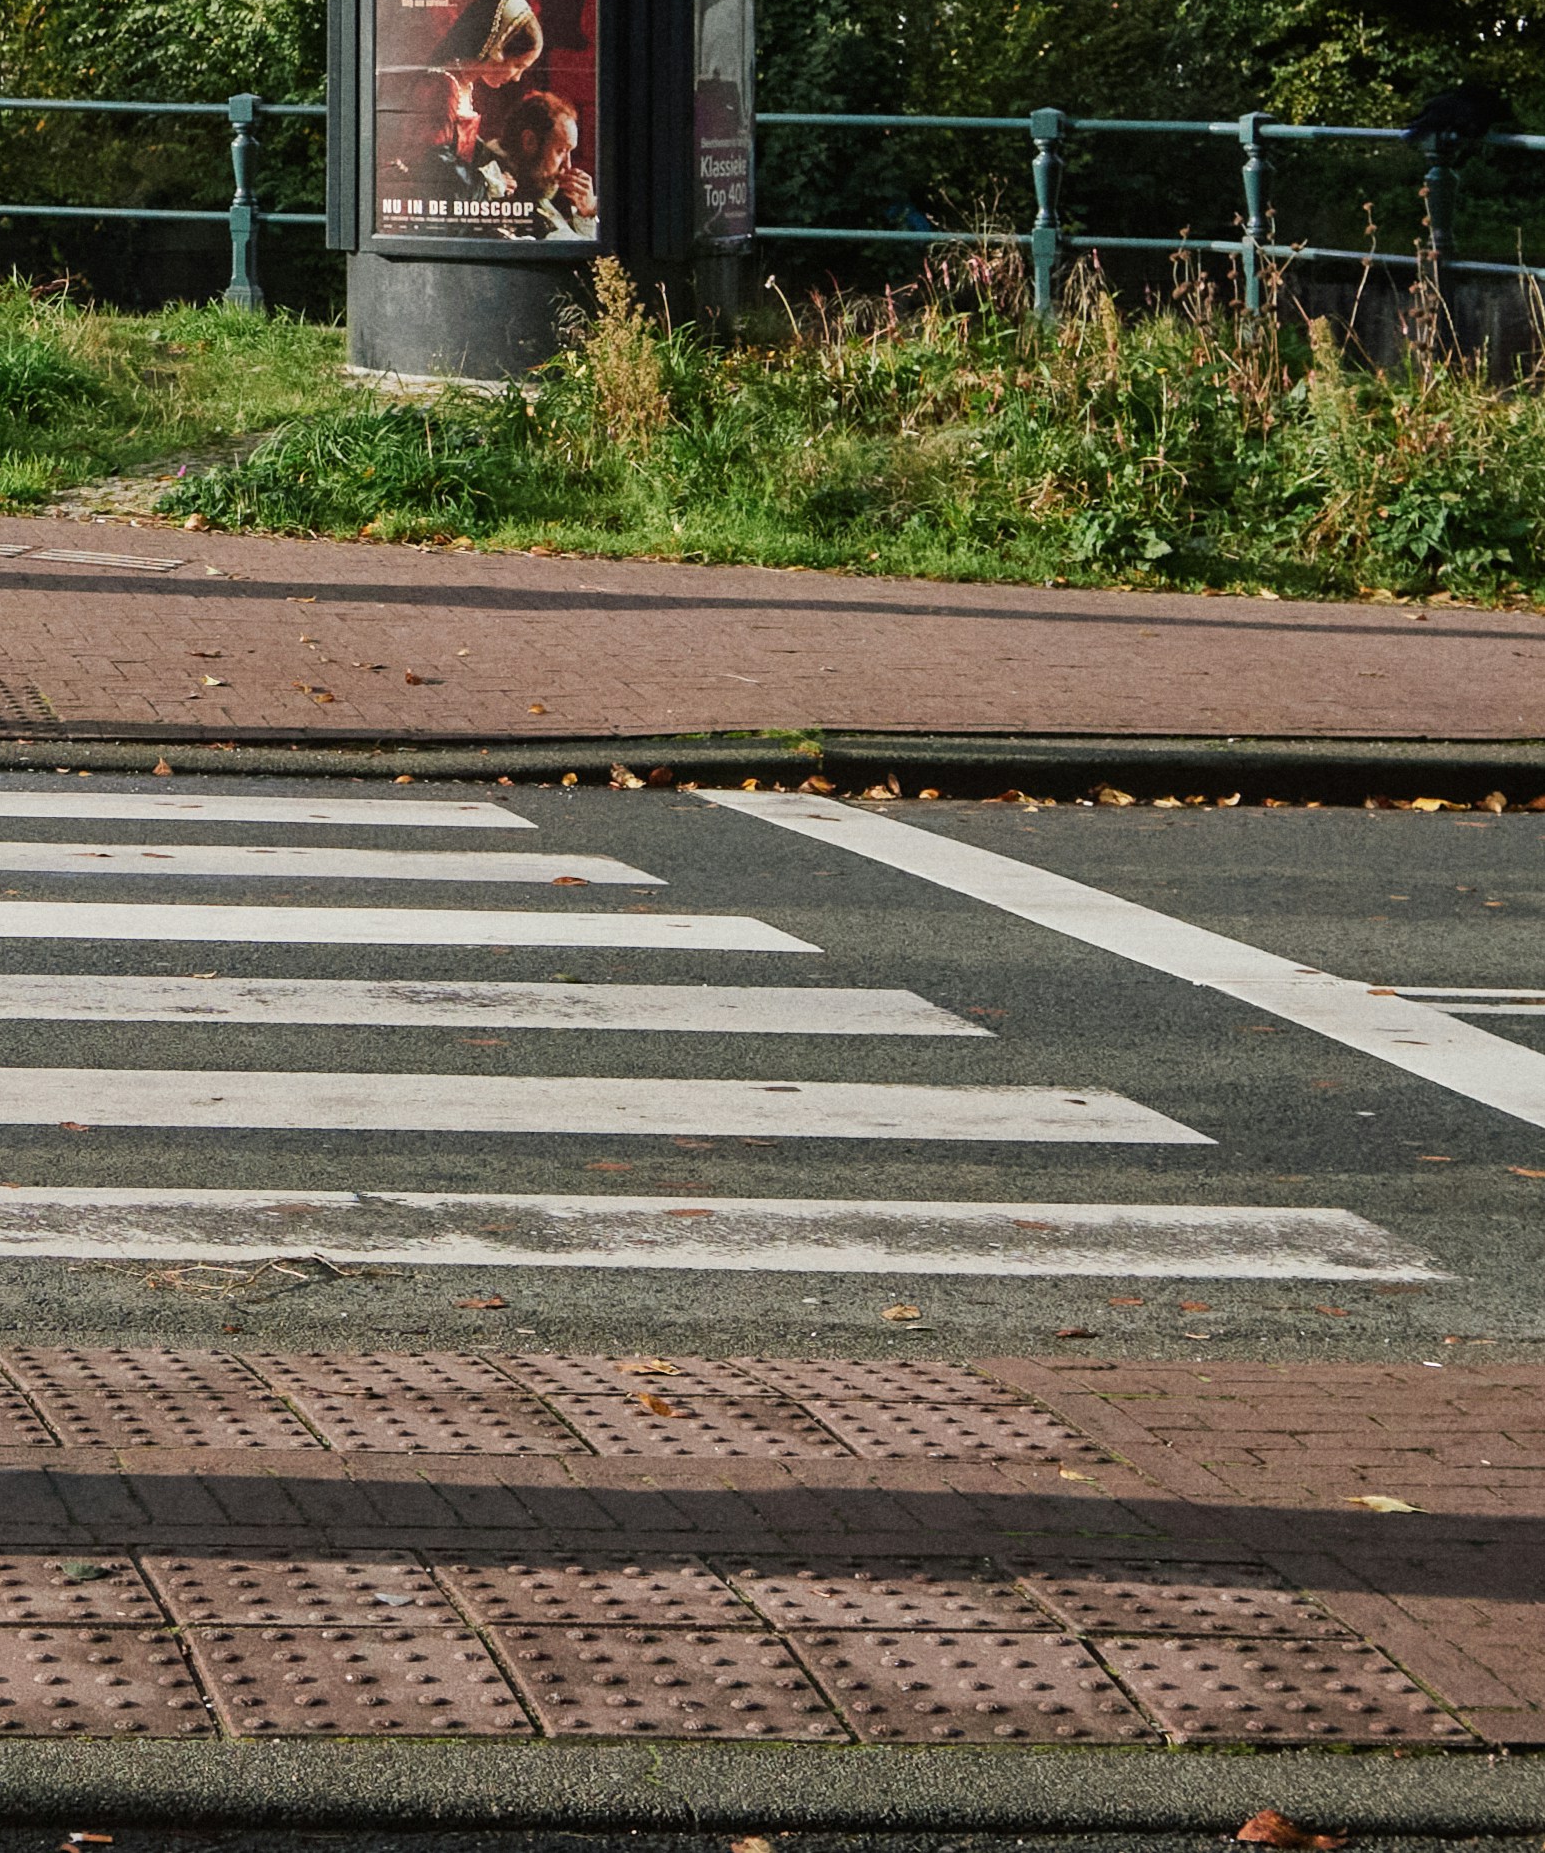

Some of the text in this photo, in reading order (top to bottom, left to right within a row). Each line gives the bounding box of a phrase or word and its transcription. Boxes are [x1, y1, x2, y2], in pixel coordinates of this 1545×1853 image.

[703, 184, 727, 209] Top
[382, 199, 534, 217] NU IN DE BIOSCOOP
